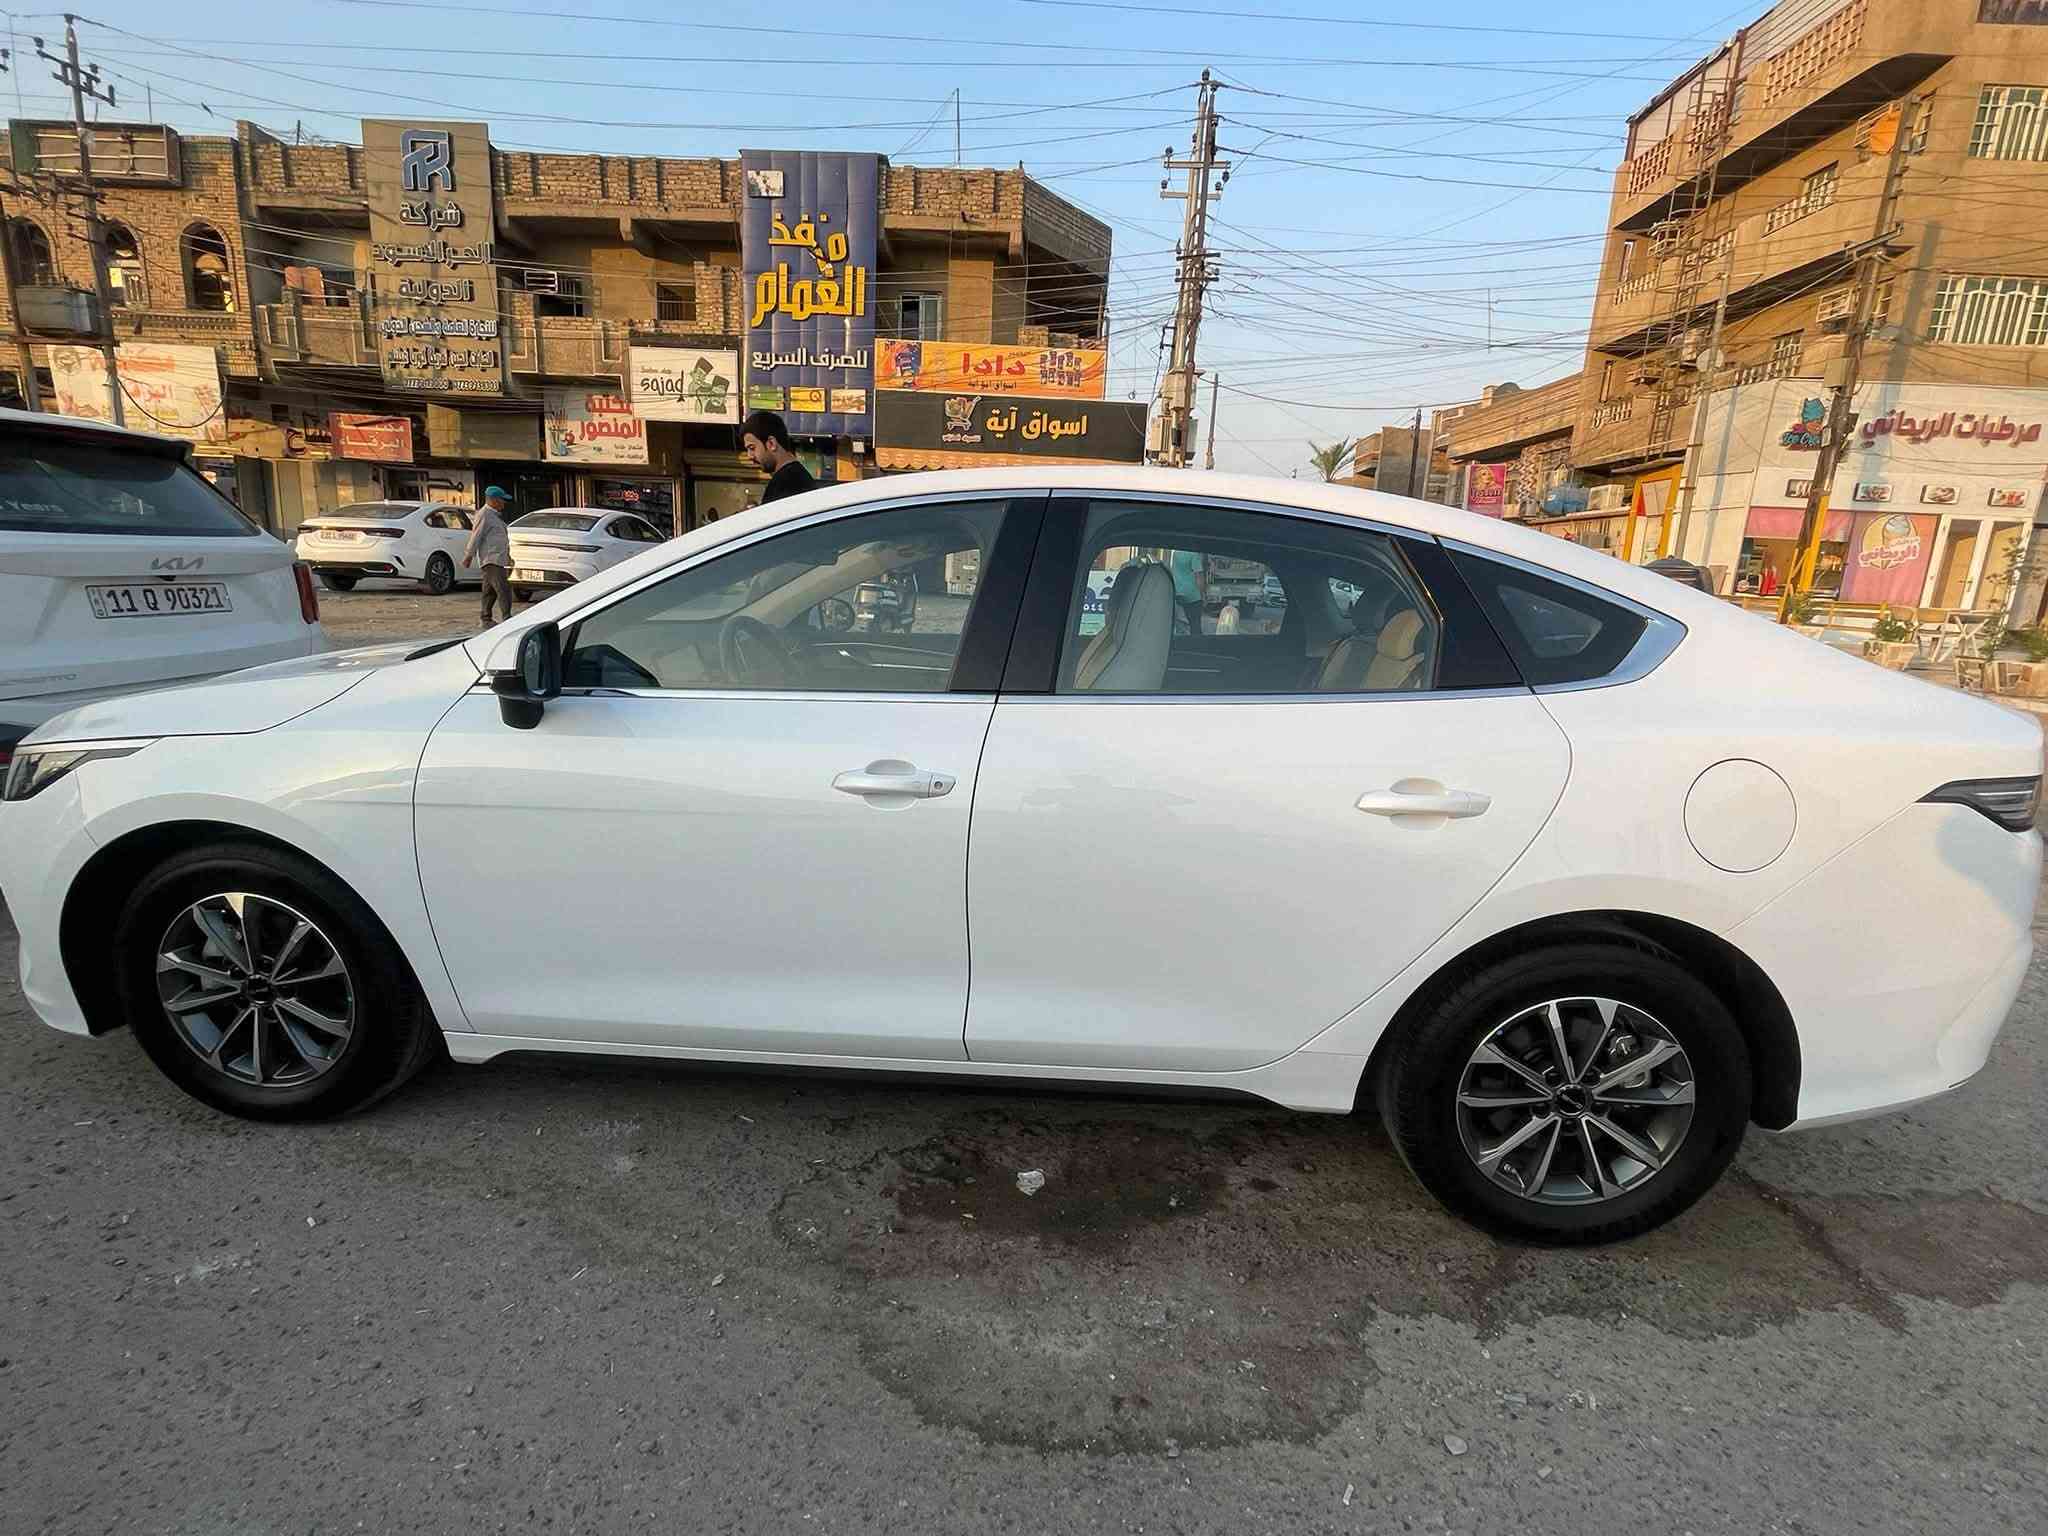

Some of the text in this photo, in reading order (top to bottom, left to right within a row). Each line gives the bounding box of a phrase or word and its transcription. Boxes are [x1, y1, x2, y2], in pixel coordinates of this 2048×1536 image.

[400, 200, 461, 231] شركة
[752, 262, 866, 328] الغمام
[752, 348, 868, 371] للصرف السريع
[962, 352, 1025, 376] دادا
[640, 369, 685, 397] sajad
[579, 417, 642, 441] المنصور
[986, 406, 1088, 440] اسواق آية
[1861, 408, 2043, 449] مرطبات الريحاني
[106, 589, 139, 613] 11
[142, 588, 161, 611] Q
[165, 586, 225, 611] 90321
